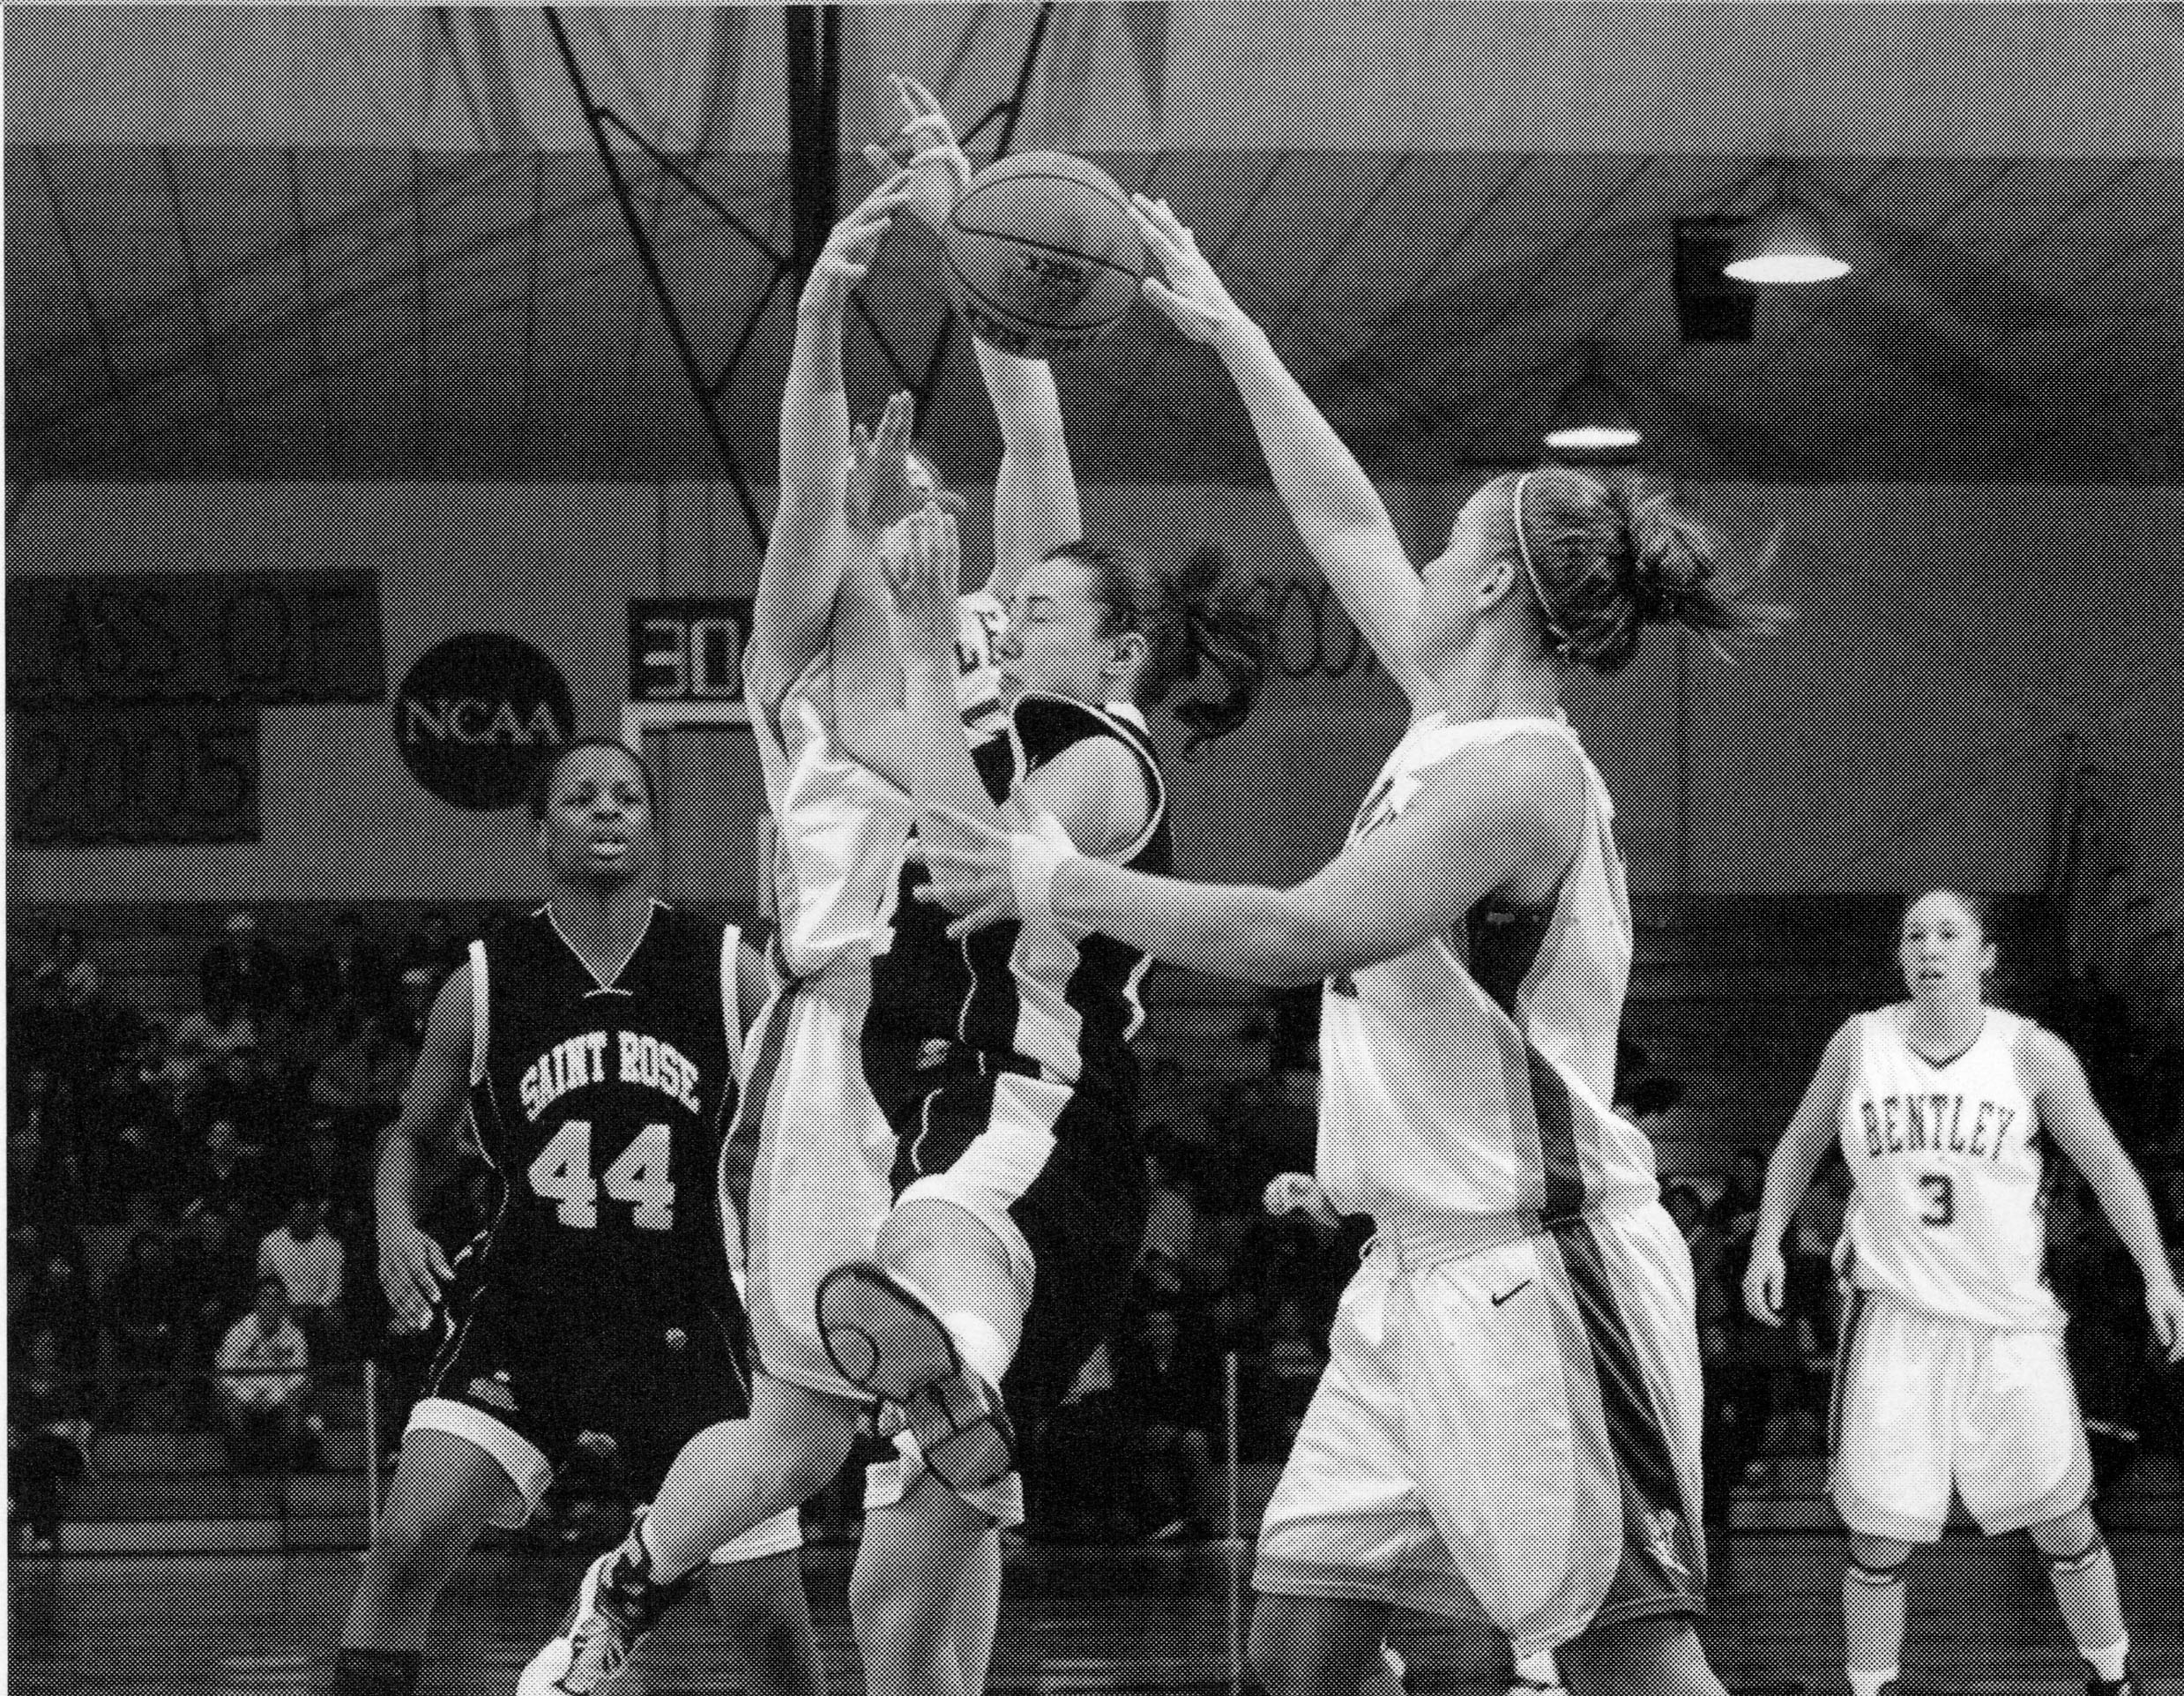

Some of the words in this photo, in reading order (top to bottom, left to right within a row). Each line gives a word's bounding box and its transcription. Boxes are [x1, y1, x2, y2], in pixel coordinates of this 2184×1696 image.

[219, 584, 362, 684] OF
[644, 618, 742, 698] 30
[403, 697, 562, 744] NCAA
[23, 727, 254, 826] 2005
[519, 1030, 607, 1122] SAINT
[617, 1030, 702, 1115] ROSE
[1860, 1093, 2016, 1162] BENTLEY
[527, 1119, 676, 1230] 44
[1917, 1174, 1955, 1225] 3
